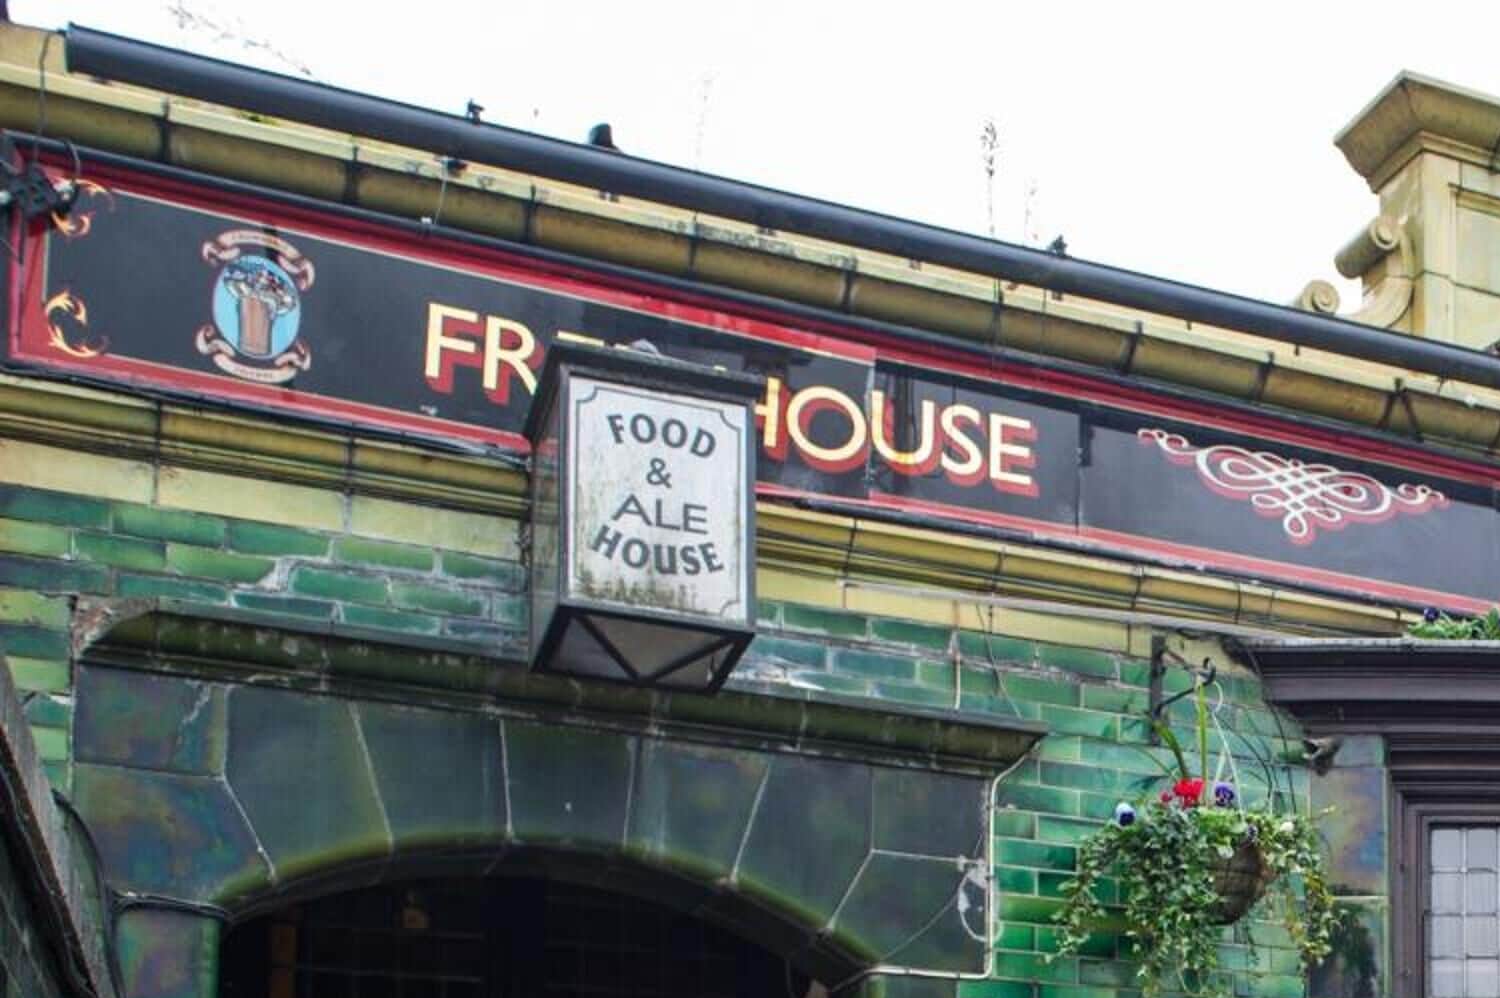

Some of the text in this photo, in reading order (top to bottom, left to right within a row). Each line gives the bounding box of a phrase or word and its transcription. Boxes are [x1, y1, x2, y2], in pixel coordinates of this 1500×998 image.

[607, 413, 717, 459] FOOD
[645, 457, 672, 489] &
[611, 493, 709, 535] ALE
[590, 525, 724, 576] HOUSE
